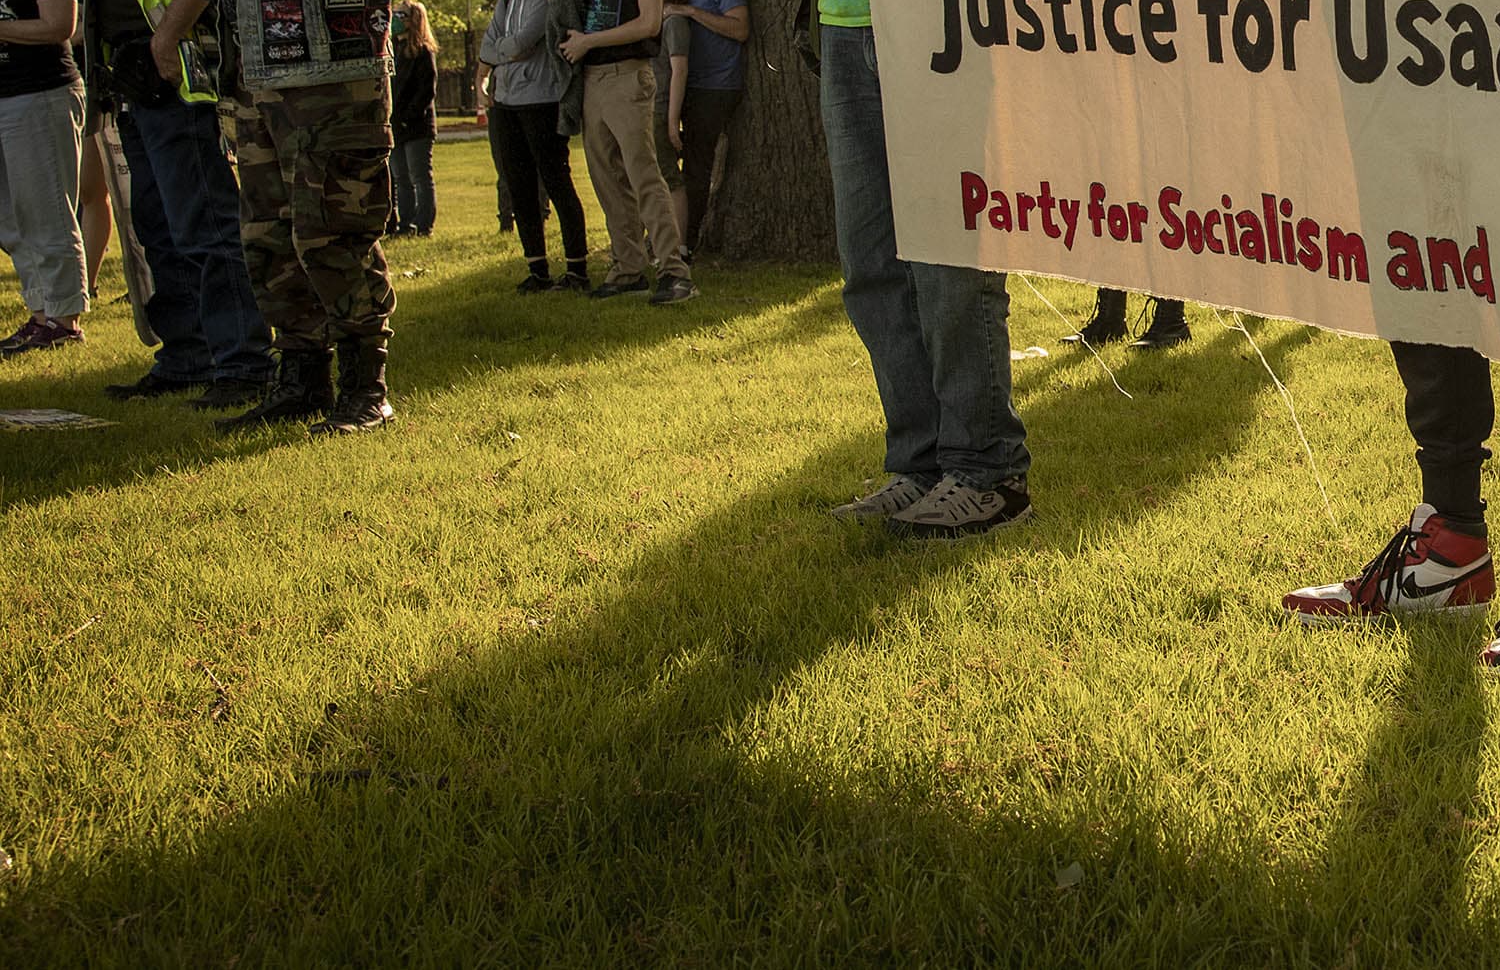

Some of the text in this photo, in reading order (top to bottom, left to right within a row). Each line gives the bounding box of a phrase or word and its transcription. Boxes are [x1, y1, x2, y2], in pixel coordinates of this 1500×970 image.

[960, 170, 1081, 251] Party
[1087, 182, 1148, 243] for
[1157, 186, 1370, 284] Socialism
[1386, 226, 1497, 304] and
